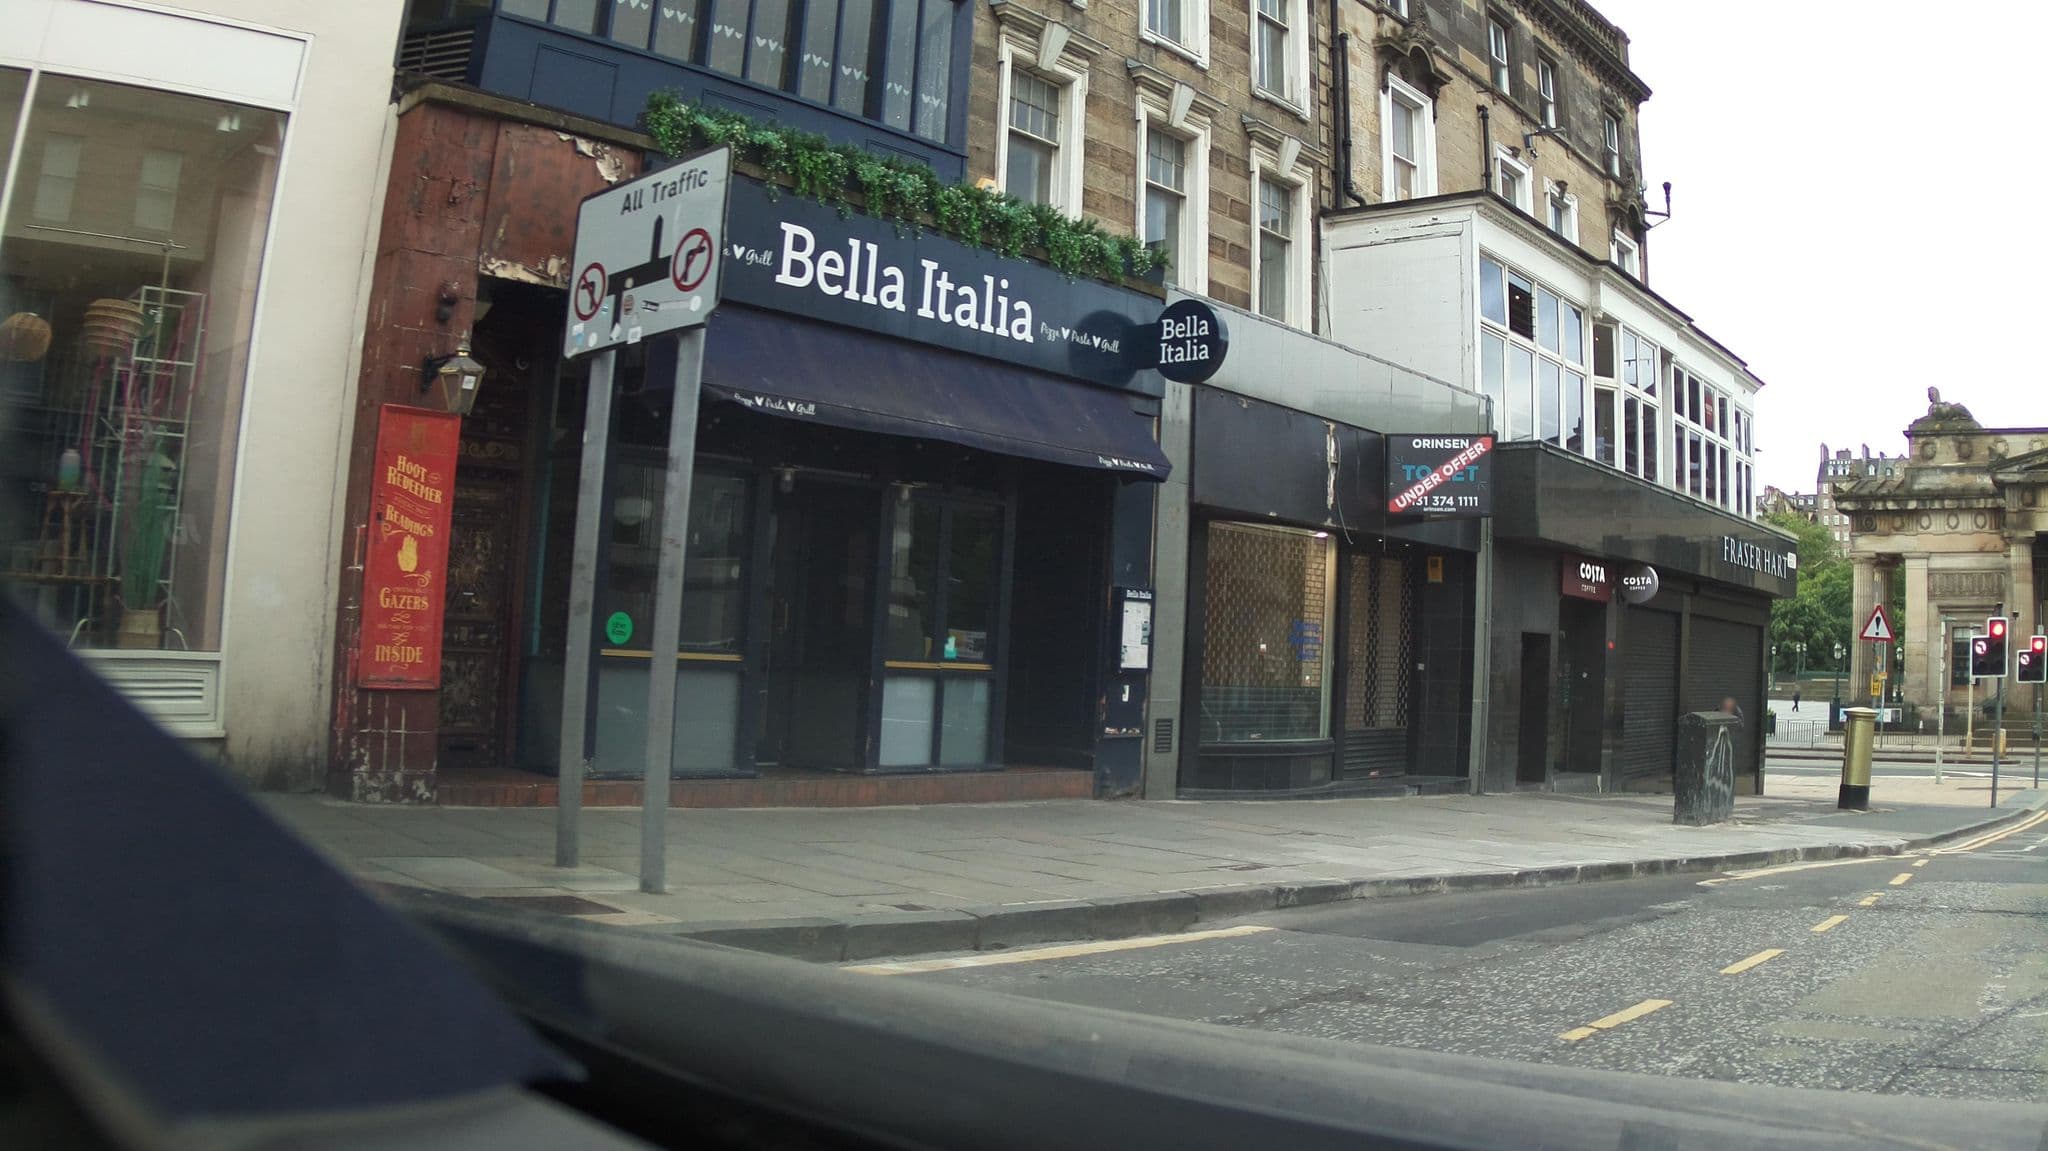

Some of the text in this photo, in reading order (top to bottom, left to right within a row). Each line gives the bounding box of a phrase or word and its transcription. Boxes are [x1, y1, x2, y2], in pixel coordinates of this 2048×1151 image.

[620, 168, 709, 216] All Traffic
[746, 249, 773, 267] Grill
[775, 221, 1034, 344] Bella Italia
[1039, 321, 1121, 354] Pizza Pasta Grill
[1160, 315, 1210, 340] Bella
[1159, 340, 1210, 365] Italia
[1412, 438, 1470, 449] ORINSEN
[397, 455, 428, 483] HOOT
[1394, 441, 1487, 509] UNDER OFFER
[1402, 464, 1433, 481] TO
[387, 465, 442, 504] REDEEMER
[1432, 495, 1455, 507] 374
[1458, 495, 1479, 507] 1111
[385, 503, 434, 537] READINGS
[1724, 535, 1762, 572] FRASER
[1764, 548, 1788, 580] HART
[1580, 562, 1606, 584] COSTA
[1623, 576, 1652, 586] COSTA
[380, 586, 430, 611] GAZERS
[375, 644, 425, 664] INSIDE
